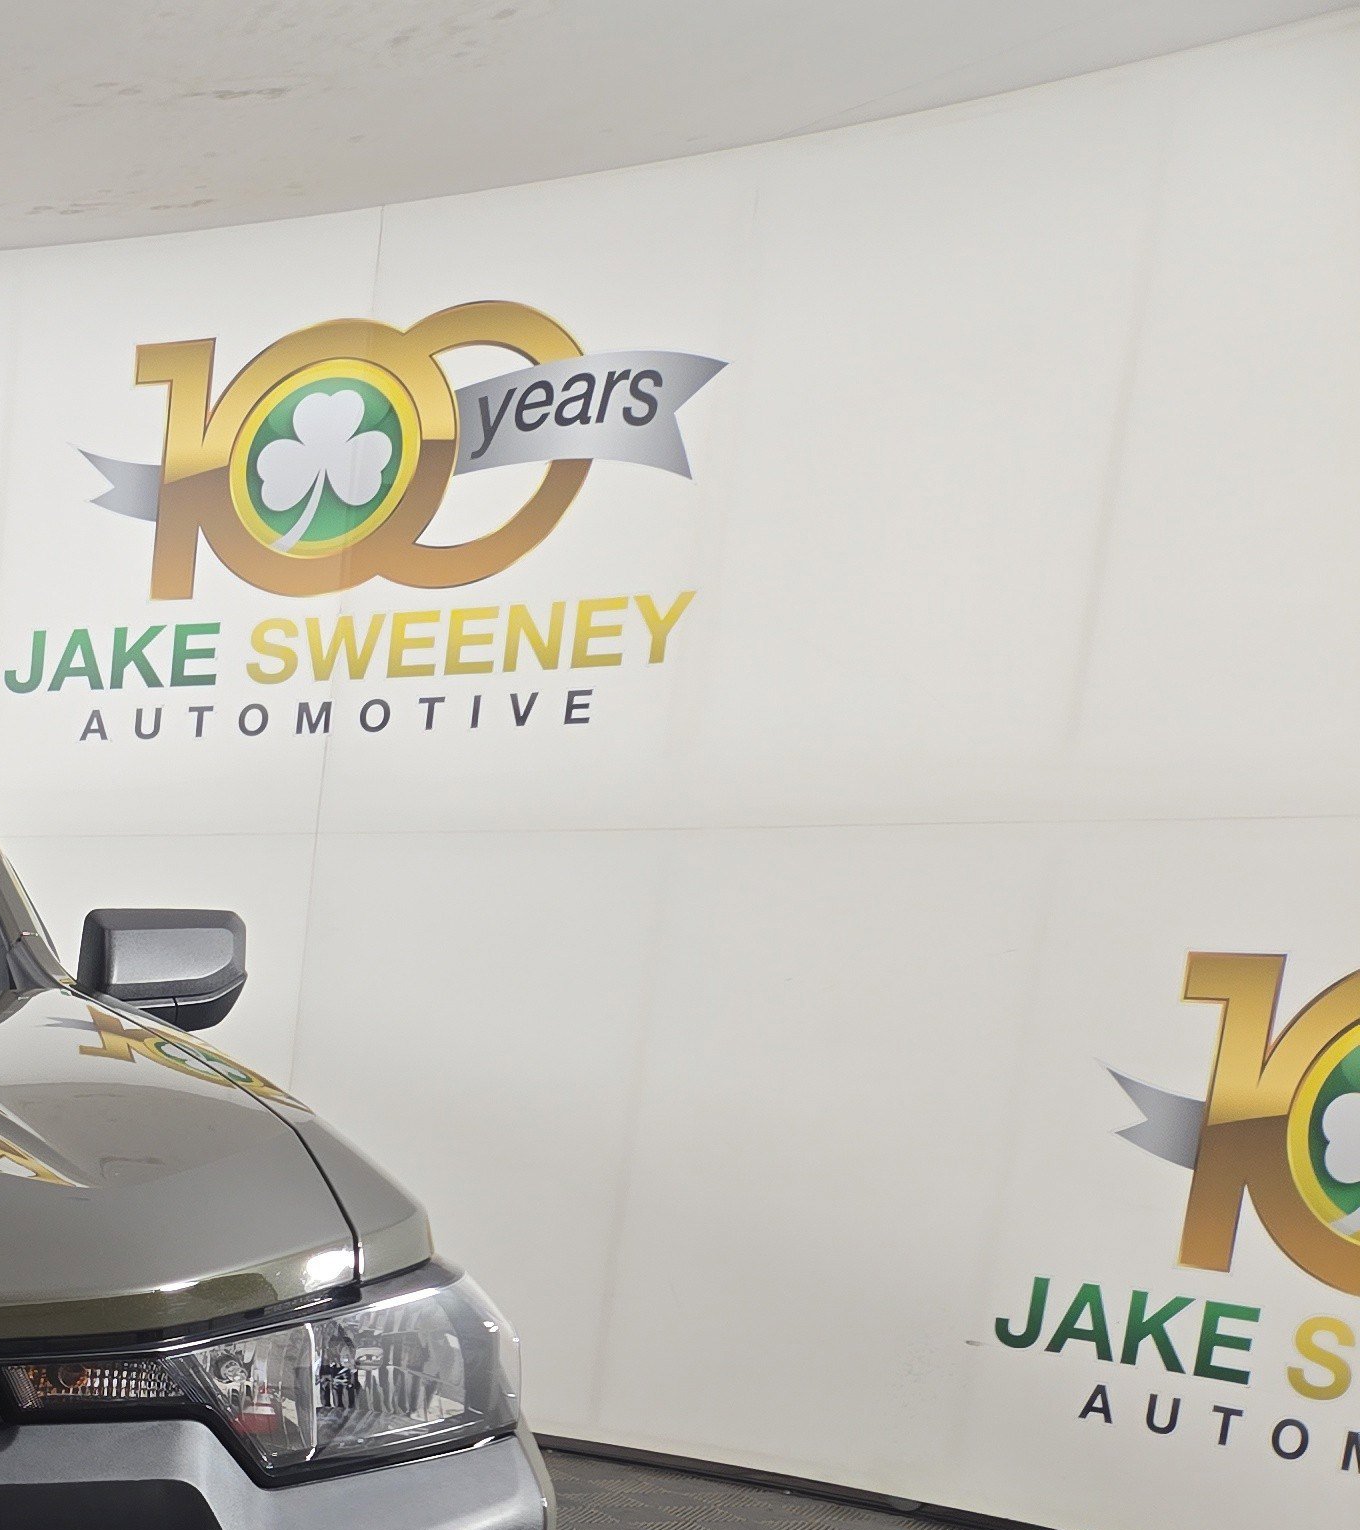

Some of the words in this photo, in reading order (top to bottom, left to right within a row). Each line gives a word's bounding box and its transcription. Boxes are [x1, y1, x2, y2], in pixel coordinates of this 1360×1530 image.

[135, 300, 594, 601] 100
[470, 367, 663, 459] years
[4, 622, 221, 694] JAKE
[246, 590, 698, 685] SWEENEY
[80, 689, 594, 742] AUTOMOTIVE
[995, 1277, 1261, 1386] JAKE
